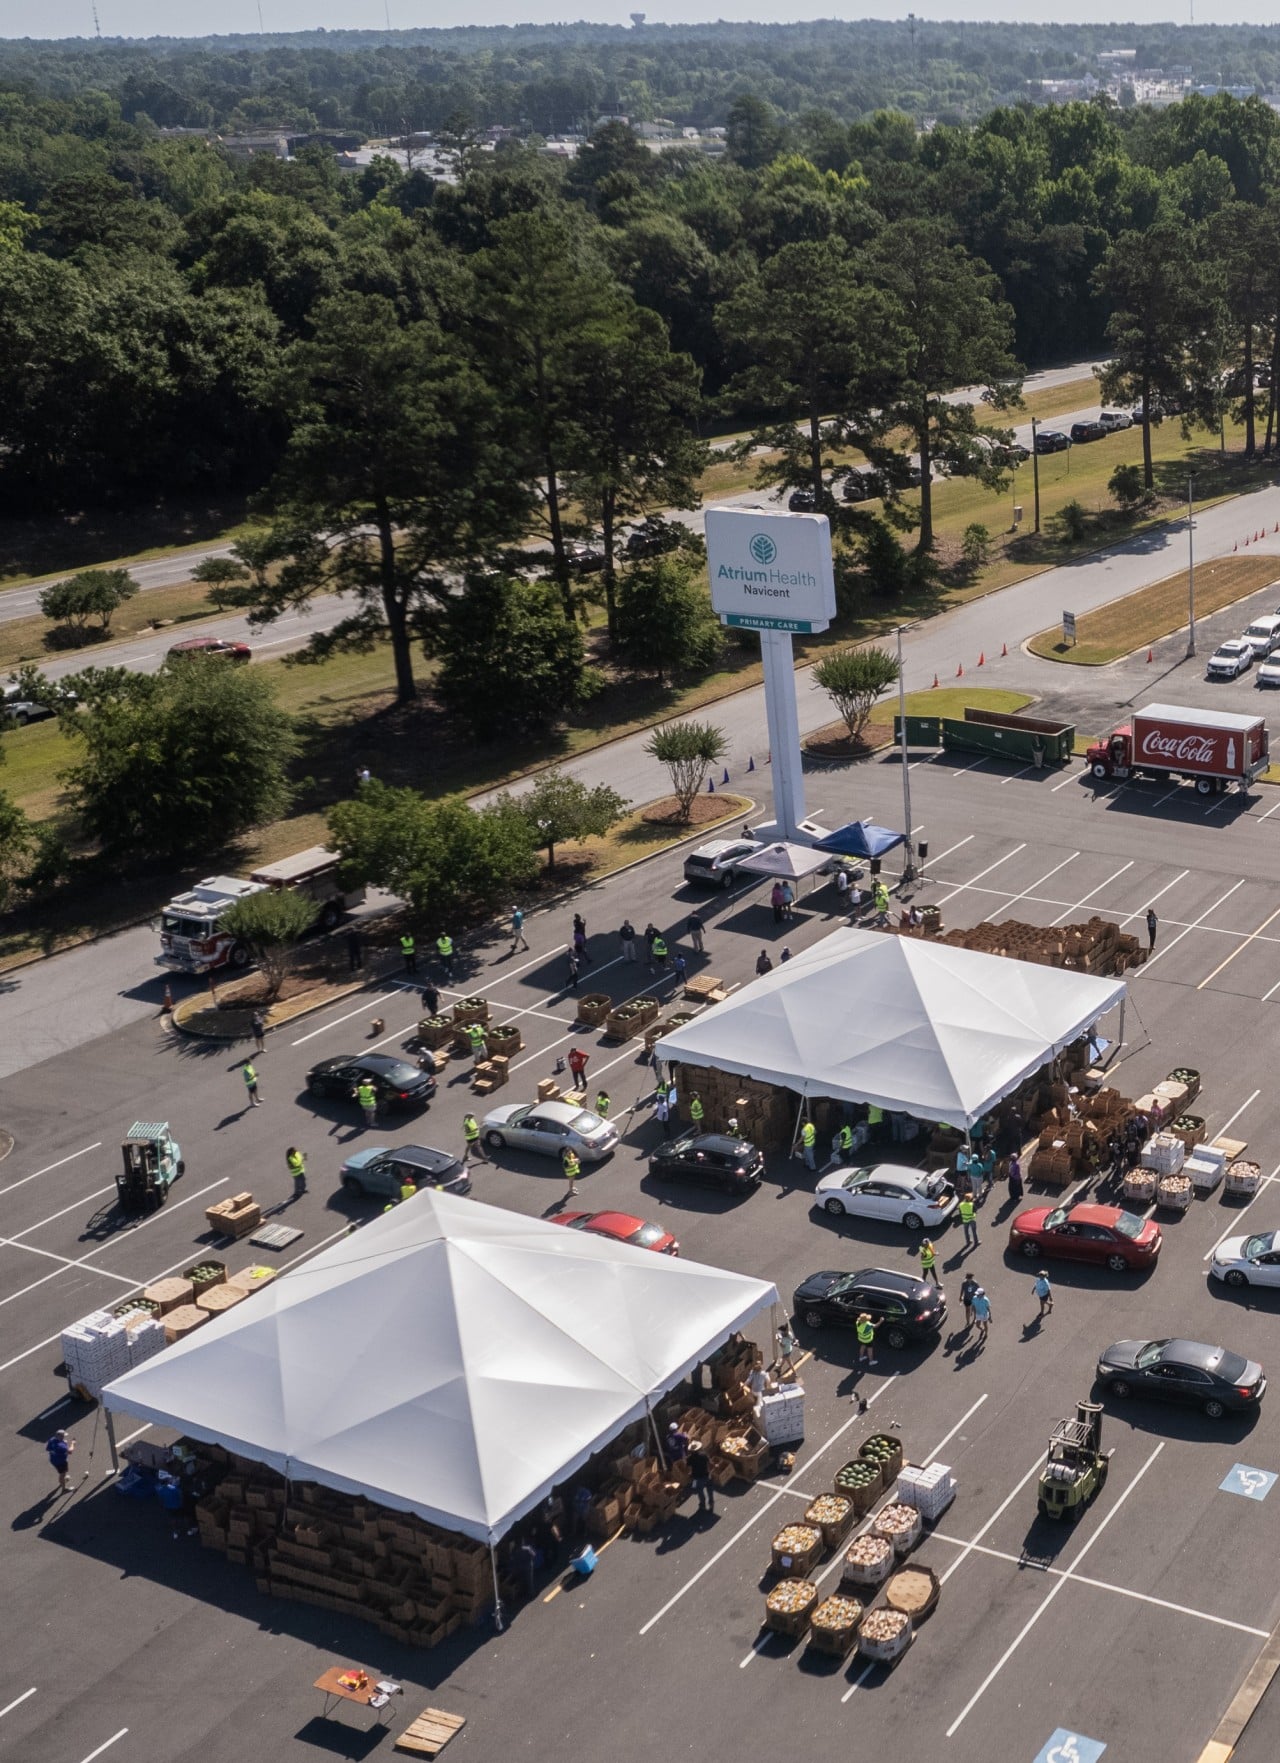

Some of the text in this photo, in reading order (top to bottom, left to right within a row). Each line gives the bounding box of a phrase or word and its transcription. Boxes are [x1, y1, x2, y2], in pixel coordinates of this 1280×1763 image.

[717, 564, 816, 587] Atrium Health
[743, 584, 791, 598] Navicent
[739, 618, 799, 630] PRIMARY CARE
[1142, 730, 1218, 763] Coca-Cola
